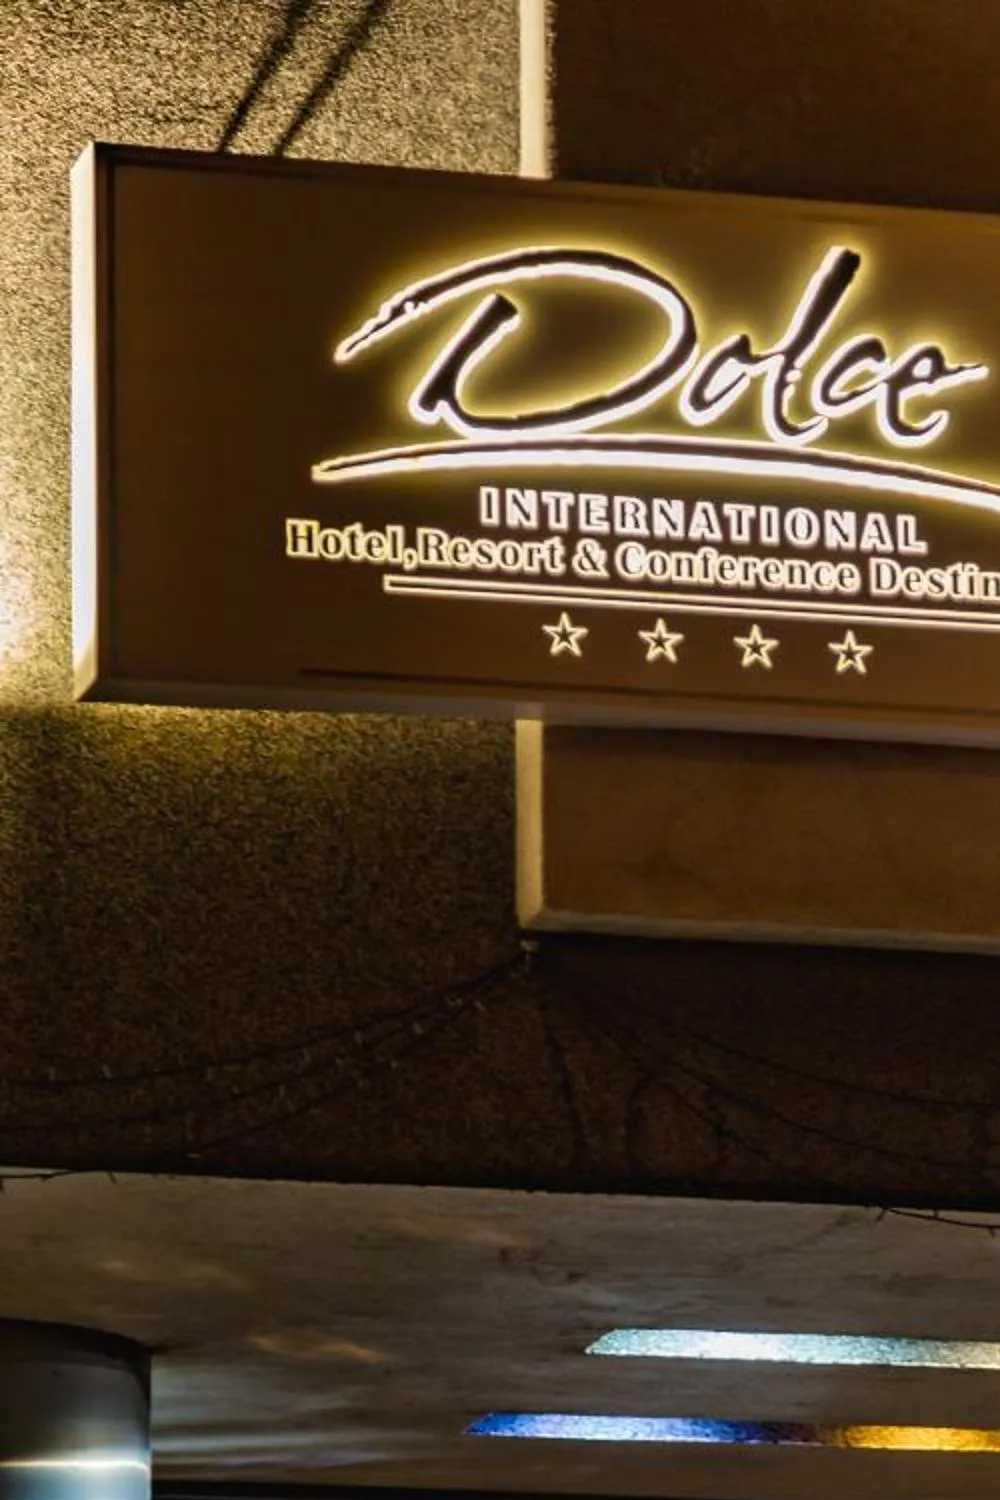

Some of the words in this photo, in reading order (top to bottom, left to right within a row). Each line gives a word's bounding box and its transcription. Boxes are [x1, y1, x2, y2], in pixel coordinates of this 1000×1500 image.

[334, 246, 989, 447] Dolce
[480, 485, 928, 556] INTERNATIONAL
[572, 539, 609, 578] &
[615, 540, 861, 593] Conference
